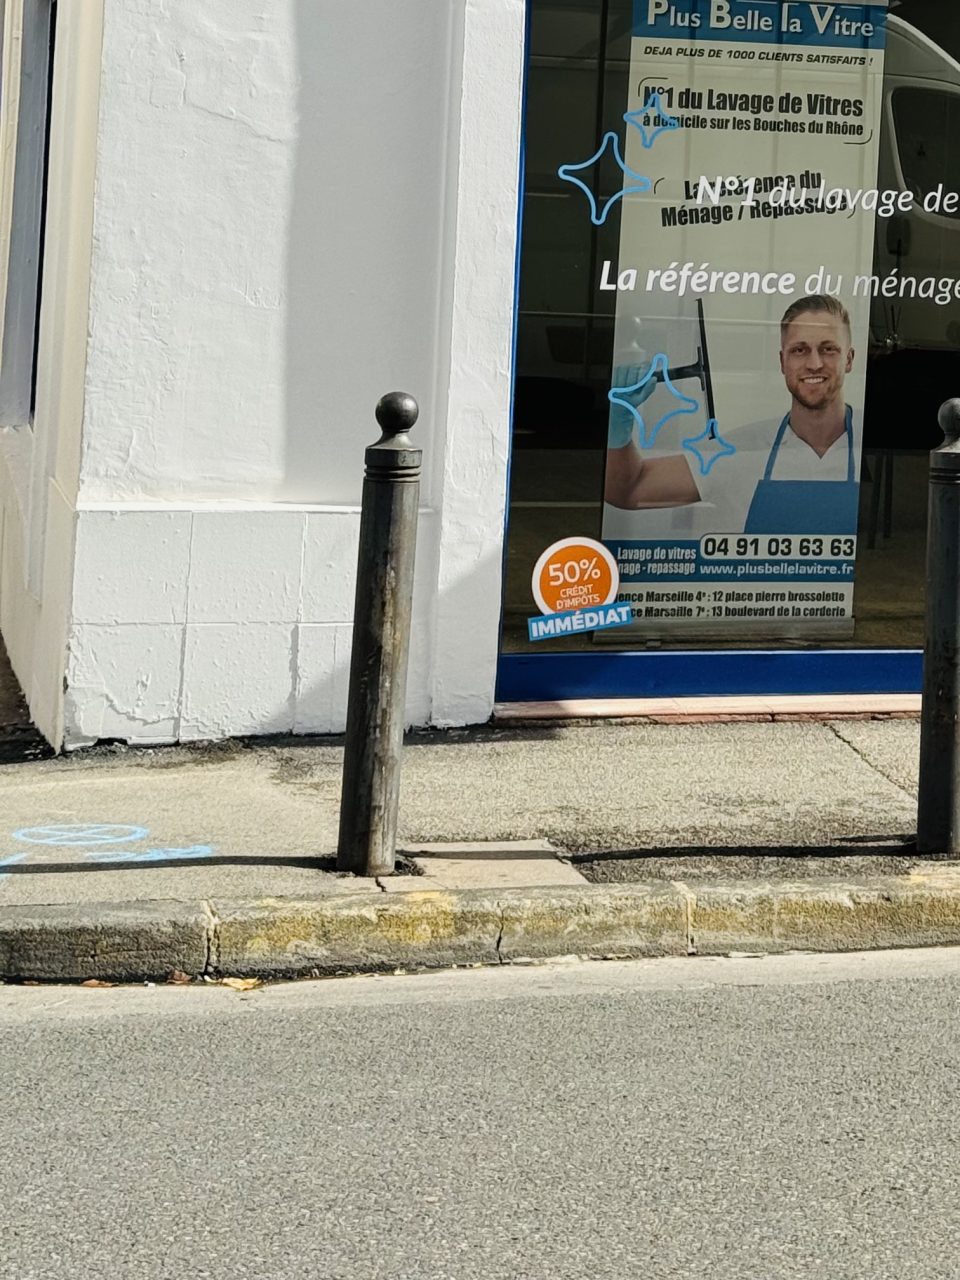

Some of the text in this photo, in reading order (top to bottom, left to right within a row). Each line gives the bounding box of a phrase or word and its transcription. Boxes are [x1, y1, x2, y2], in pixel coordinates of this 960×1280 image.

[808, 4, 874, 37] Vitre
[643, 46, 673, 57] DEJA
[676, 47, 705, 58] PLUS
[708, 48, 723, 58] DE
[726, 49, 755, 60] 1000
[758, 51, 803, 62] CLIENTS
[806, 54, 866, 66] SATISFAITS
[678, 88, 702, 109] du
[707, 88, 774, 115] Lavage
[778, 92, 802, 114] de
[807, 93, 863, 117] Vitres
[643, 112, 650, 126] à
[710, 119, 729, 130] sur
[732, 116, 751, 131] les
[753, 118, 805, 133] Bouches
[808, 120, 823, 134] du
[826, 120, 863, 136] Rhône
[799, 170, 822, 189] du
[696, 175, 757, 206] N°1
[769, 178, 808, 209] du
[817, 179, 914, 218] lavage
[923, 183, 959, 213] de
[661, 205, 733, 227] Ménage
[599, 260, 637, 292] La
[646, 261, 796, 297] référence
[805, 265, 843, 297] du
[617, 547, 696, 561] Lavage de vitres
[704, 537, 855, 557] 04 91 03 63 63
[549, 557, 601, 586] 50%
[647, 562, 696, 575] repassage
[700, 562, 854, 577] www.plusbellelavitre.fr
[646, 591, 694, 602] Marseille
[712, 591, 724, 602] 12
[724, 591, 753, 603] place
[755, 591, 786, 603] pierre
[787, 591, 845, 602] brossolette
[711, 606, 723, 617] 13
[724, 605, 775, 617] boulevard
[777, 606, 790, 617] de
[791, 606, 800, 617] la
[802, 606, 846, 617] corderie
[531, 606, 632, 638] IMMÉDIAT
